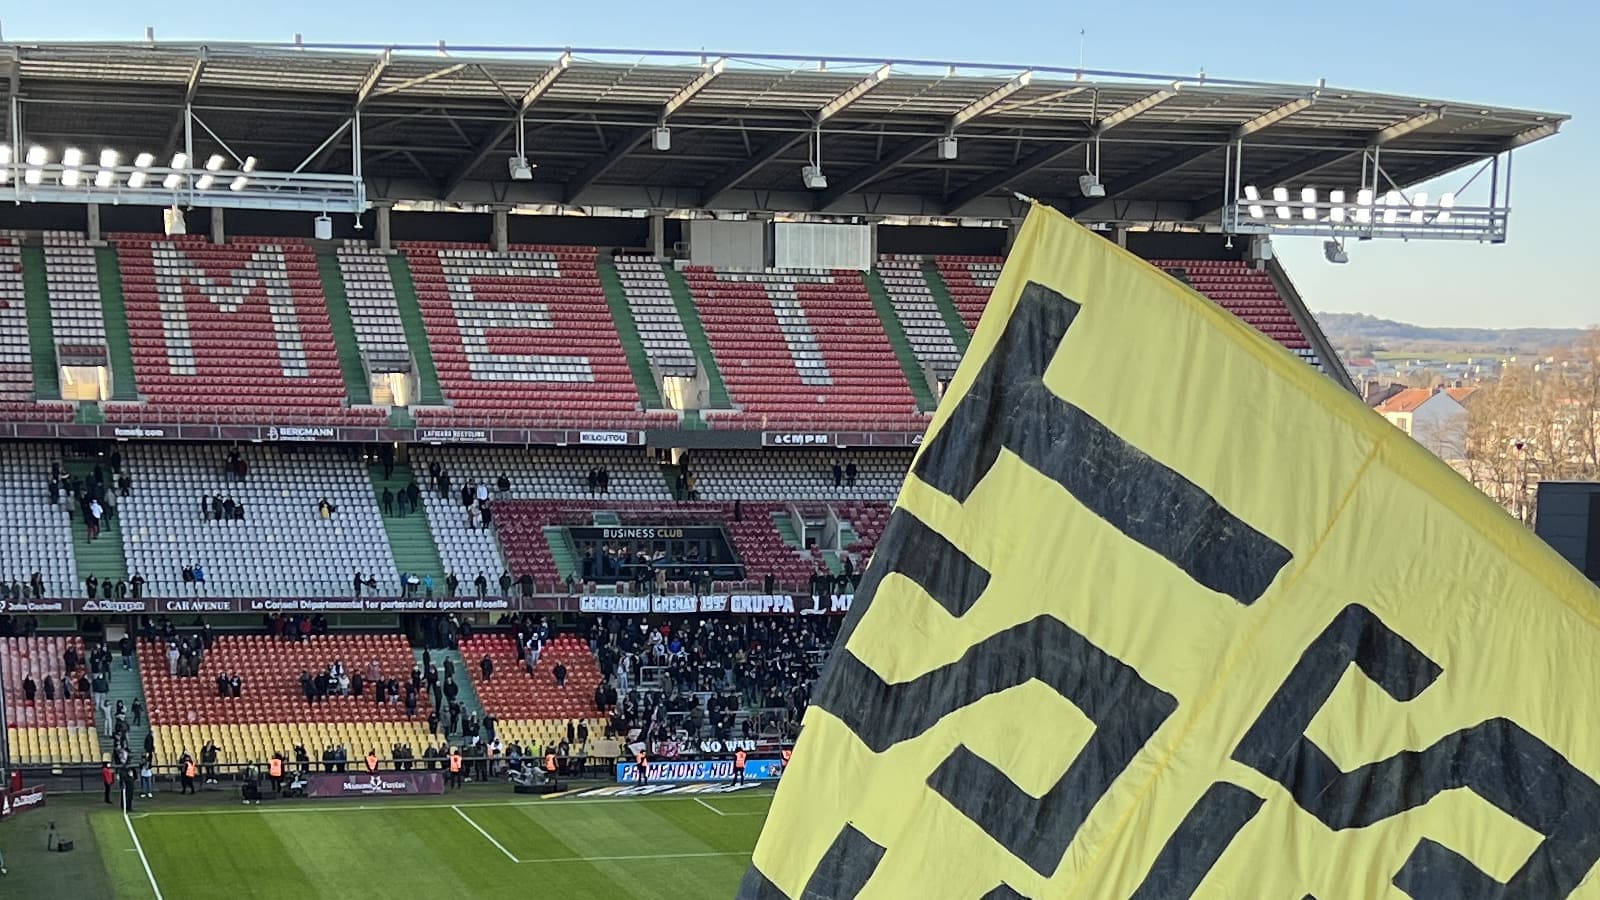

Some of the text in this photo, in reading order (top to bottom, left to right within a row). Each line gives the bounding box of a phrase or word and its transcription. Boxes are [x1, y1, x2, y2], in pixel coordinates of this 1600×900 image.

[279, 427, 334, 436] BERGMANN
[603, 528, 683, 538] BUSINESS CLUB
[99, 600, 145, 611] Kappa
[166, 600, 231, 611] CAR AVENUE
[265, 600, 298, 610] Conseil
[365, 600, 379, 609] 1er
[380, 600, 424, 611] partenaire
[425, 600, 437, 609] du
[439, 600, 461, 611] sport
[463, 601, 474, 609] en
[475, 600, 508, 609] Moselle
[581, 596, 649, 611] GENERATION
[654, 596, 696, 611] GRENAT
[731, 595, 795, 613] GRUPPA
[700, 742, 721, 753] NO
[725, 740, 756, 752] WAR
